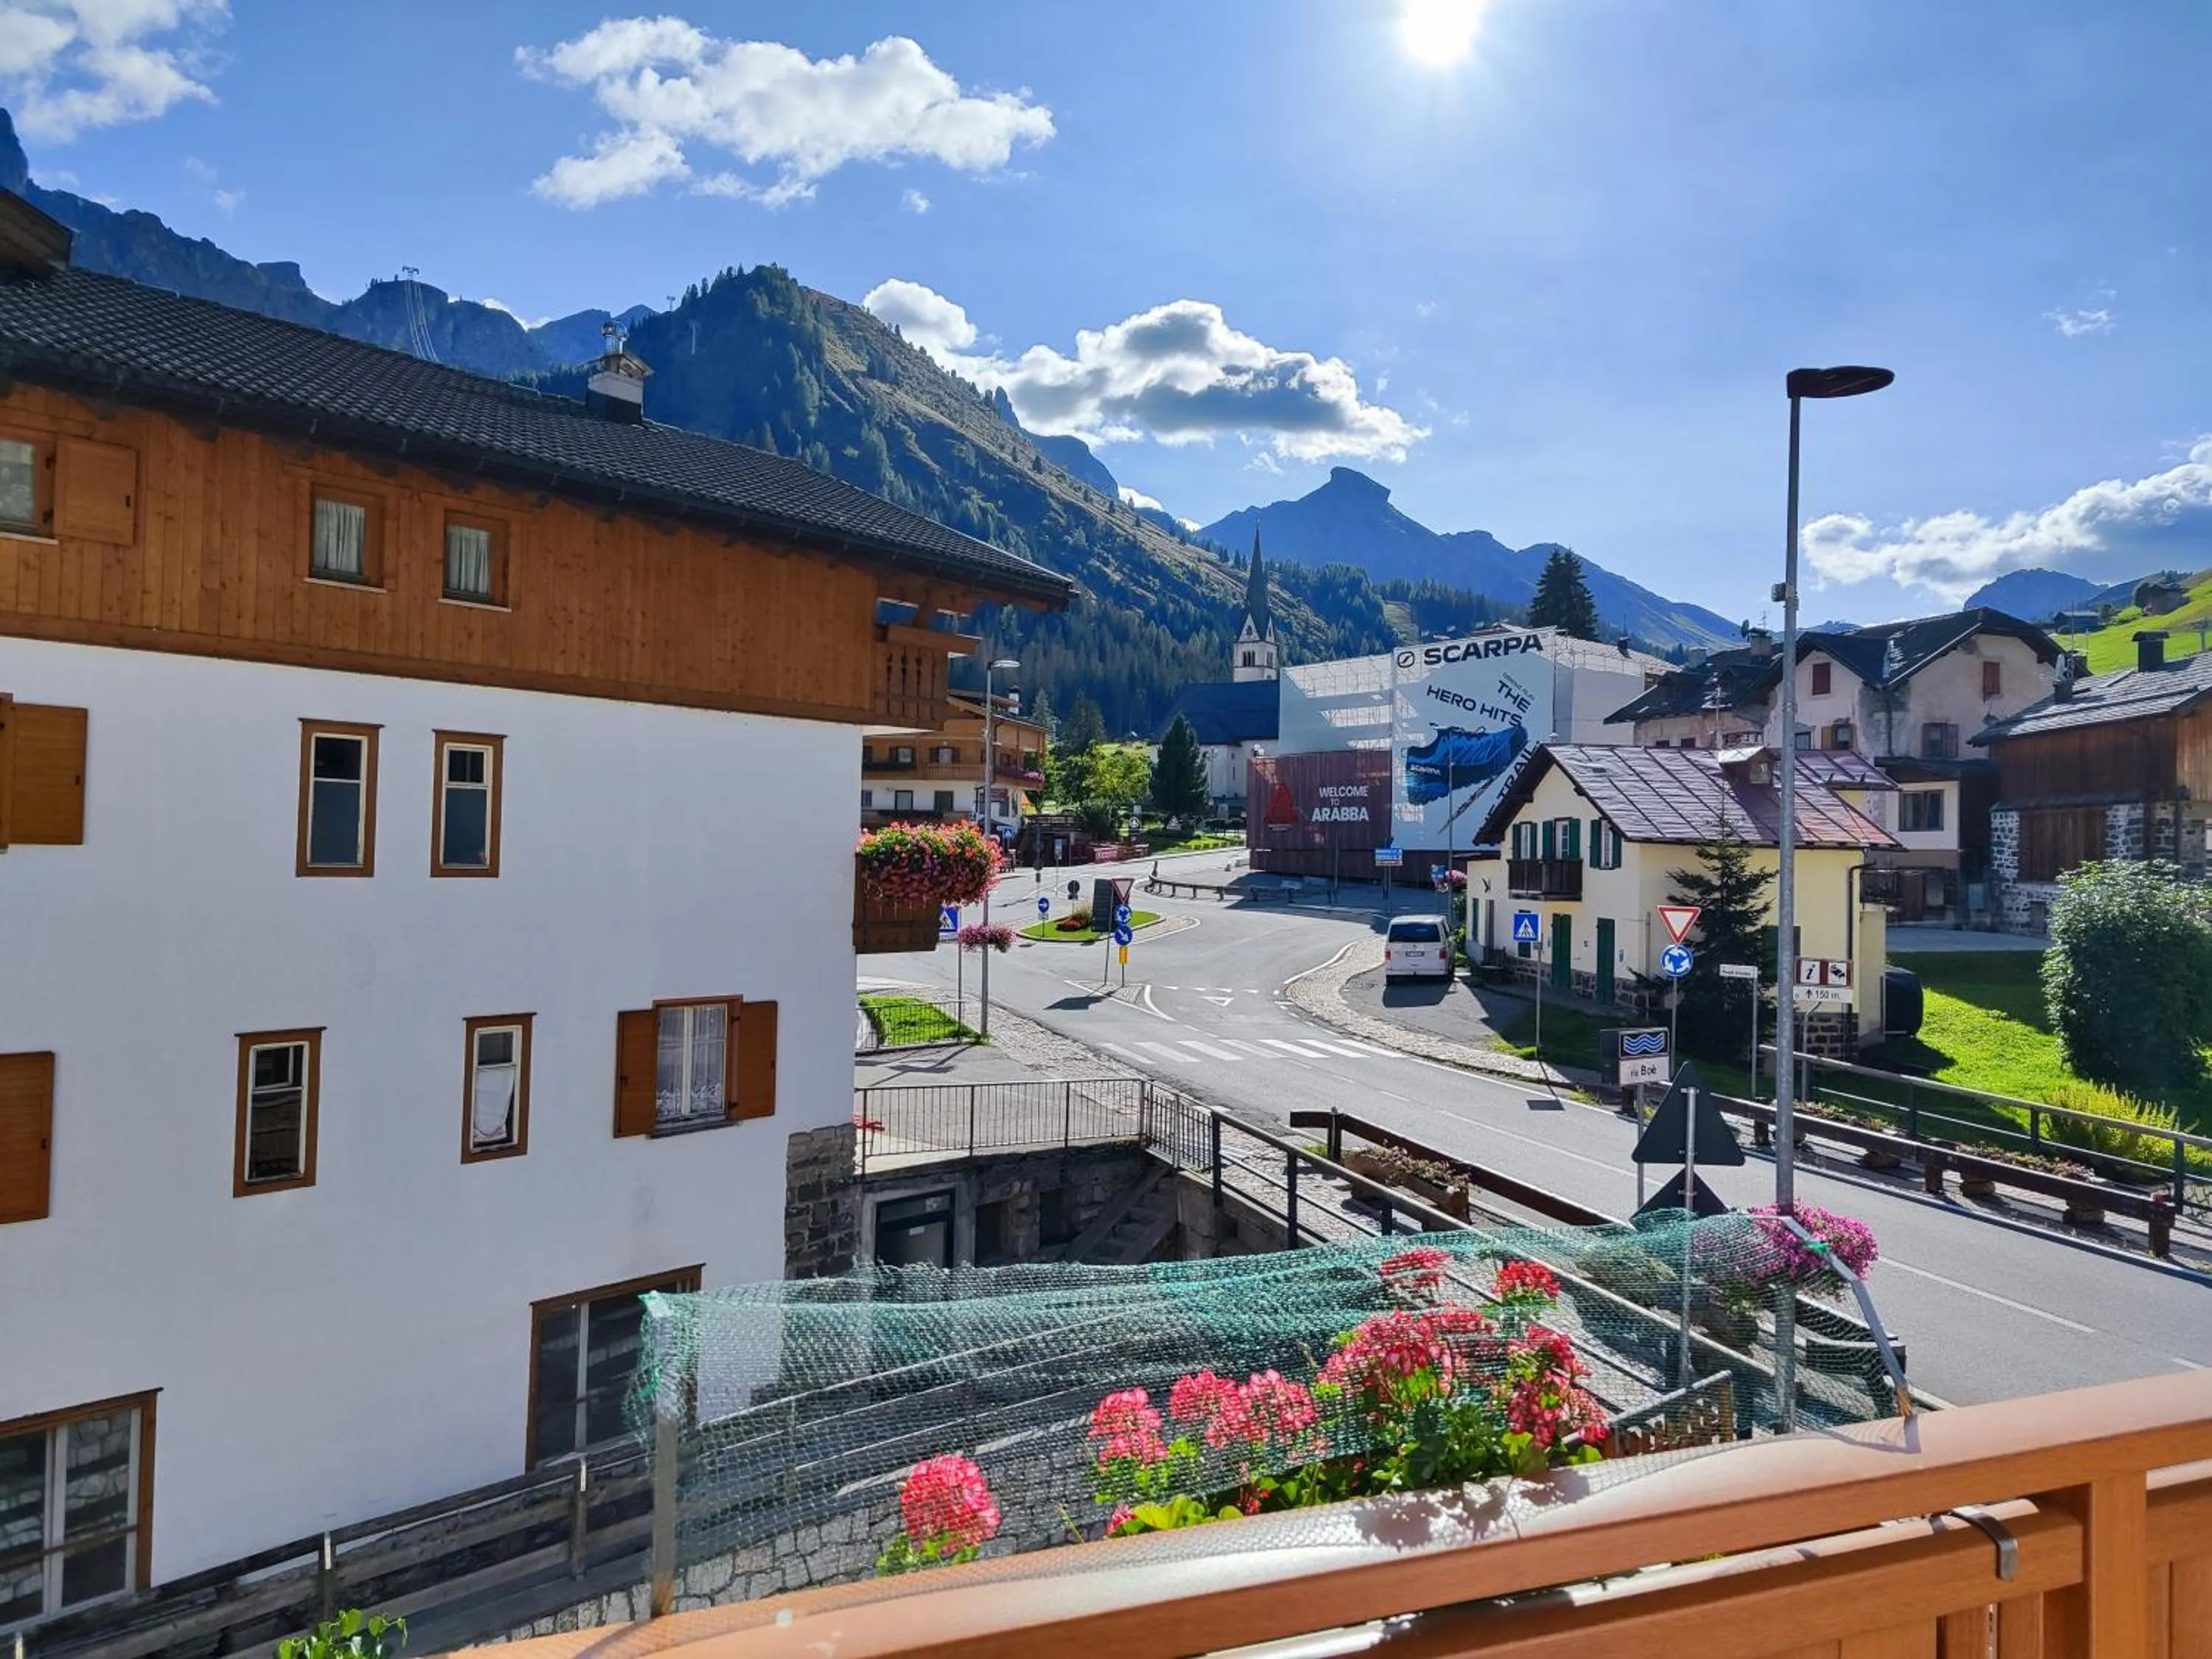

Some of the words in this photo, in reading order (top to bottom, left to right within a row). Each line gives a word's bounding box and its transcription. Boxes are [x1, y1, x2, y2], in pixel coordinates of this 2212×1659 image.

[1424, 633, 1544, 665] SCARPA
[1427, 684, 1477, 712] HERO
[1480, 703, 1523, 726] HITS
[1498, 679, 1531, 714] THE
[1319, 785, 1369, 798] WELCOME
[1330, 798, 1340, 806] TO
[1312, 807, 1369, 822] ARABBA
